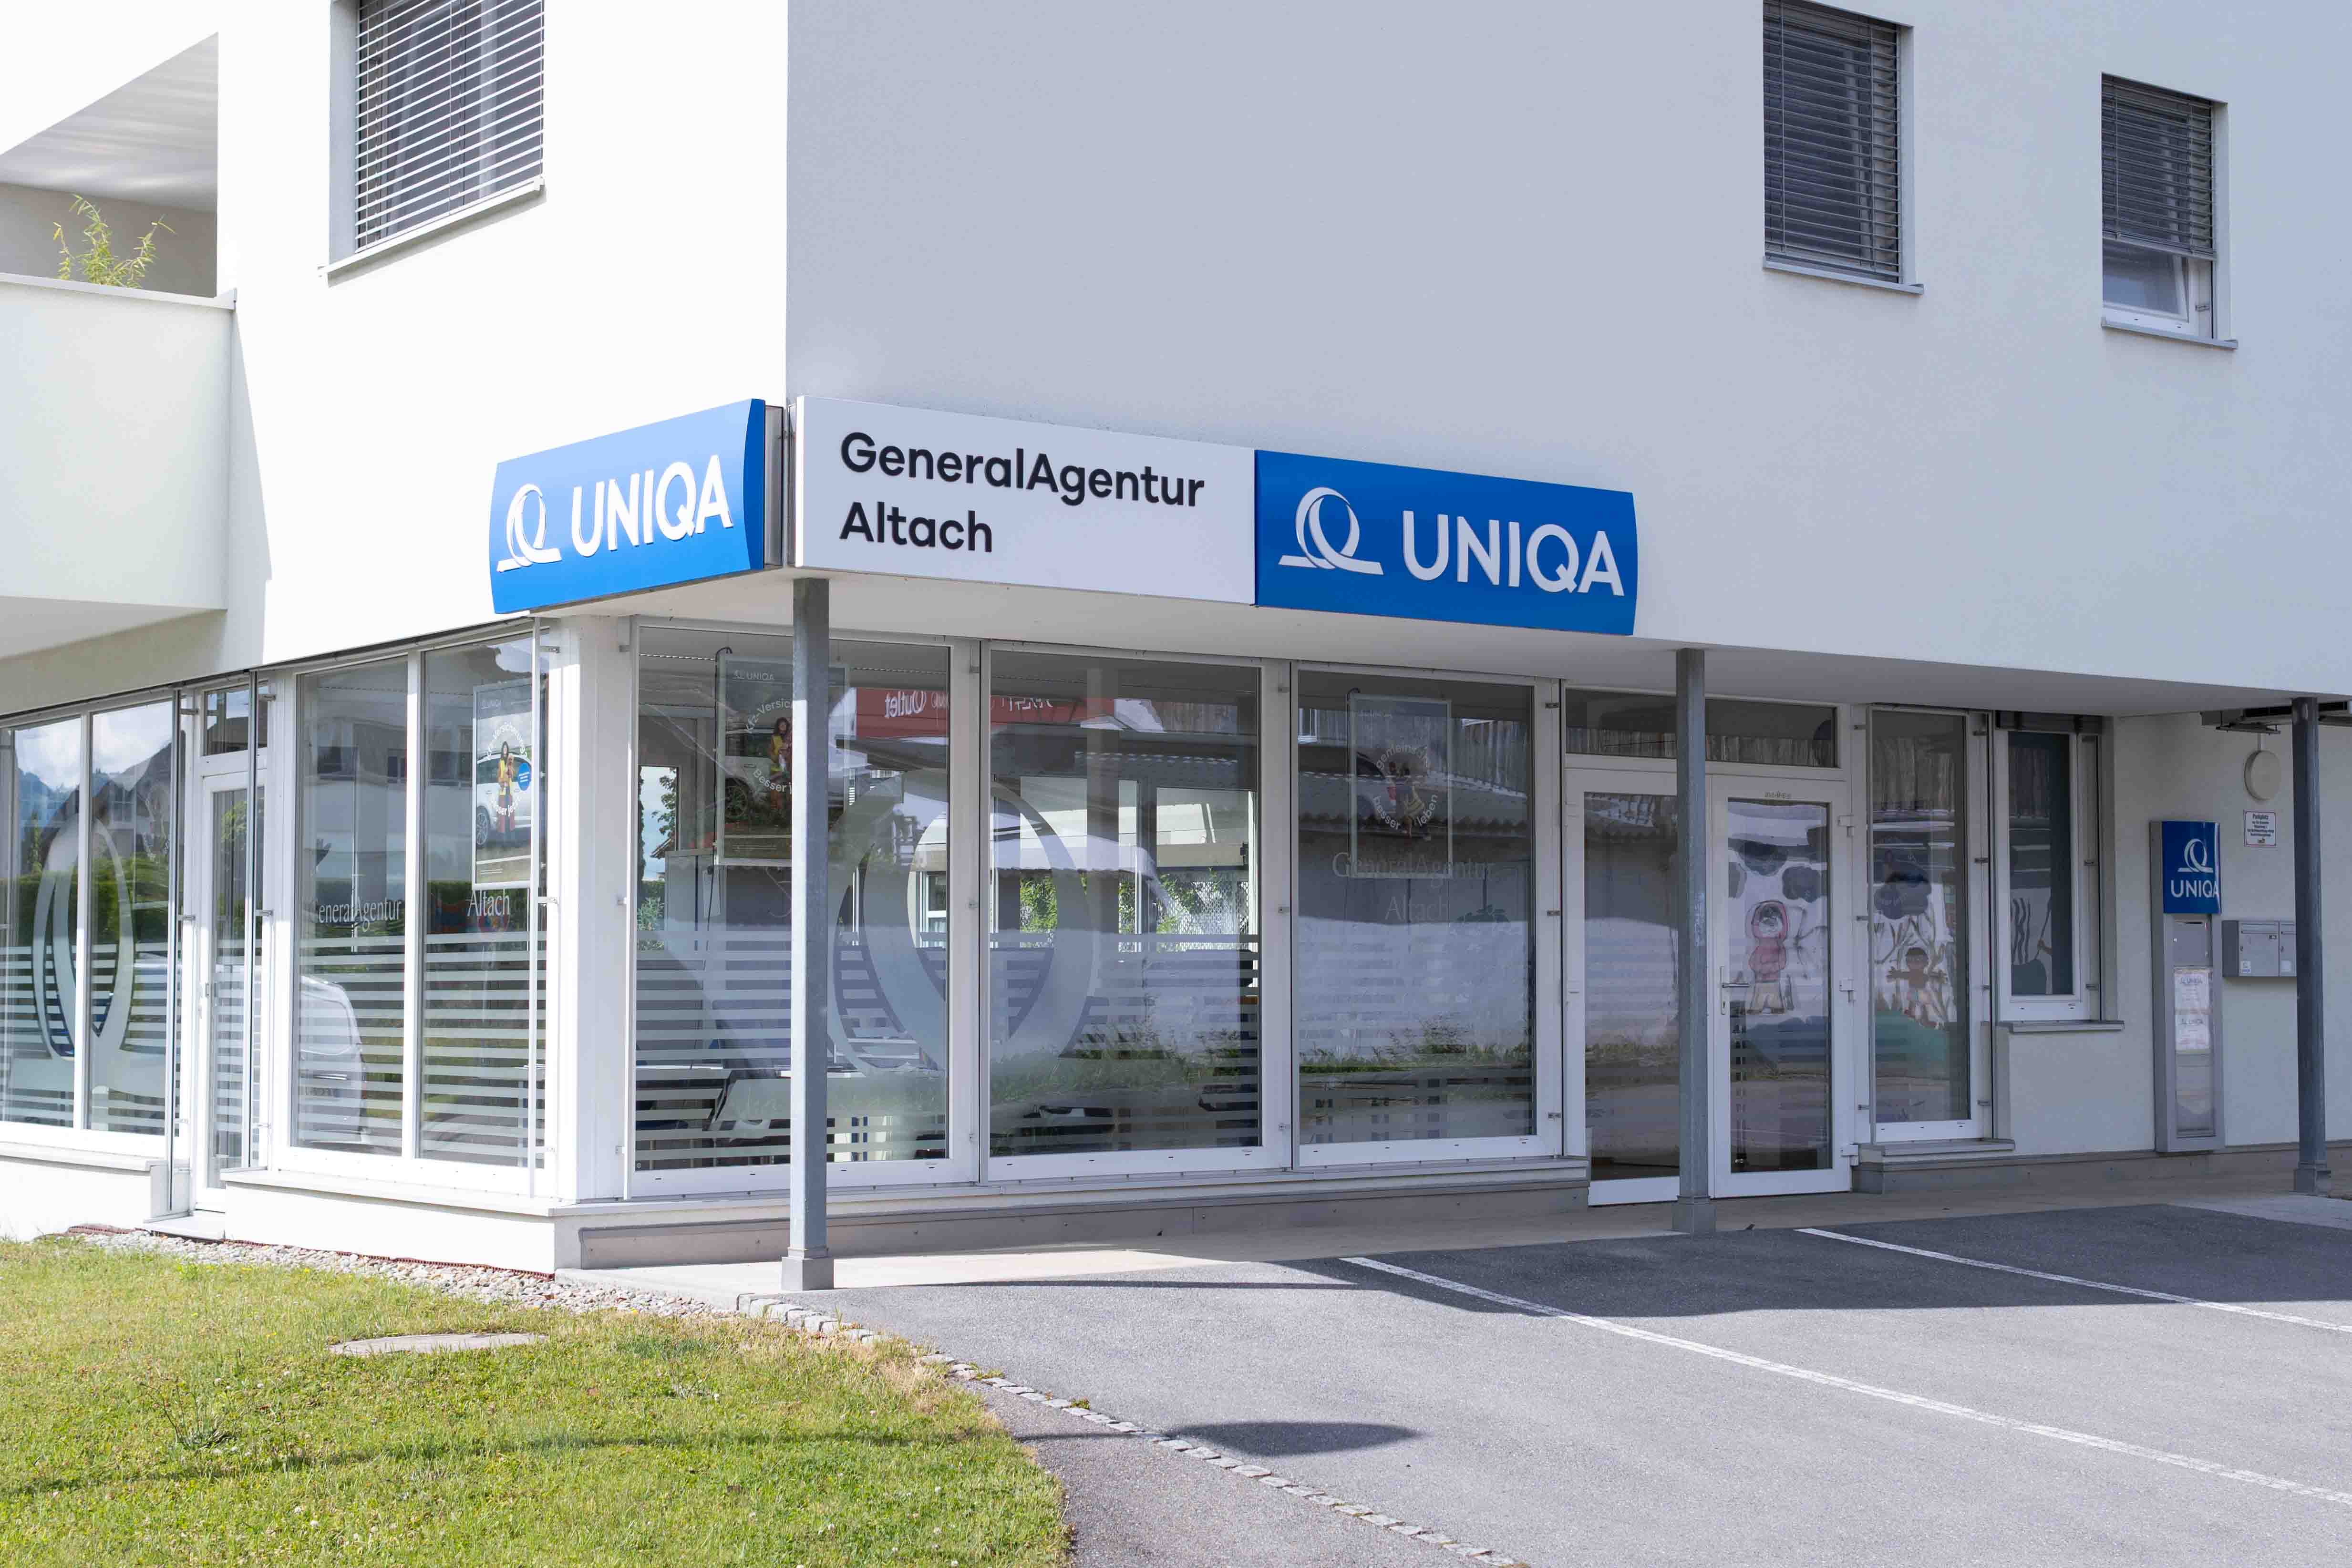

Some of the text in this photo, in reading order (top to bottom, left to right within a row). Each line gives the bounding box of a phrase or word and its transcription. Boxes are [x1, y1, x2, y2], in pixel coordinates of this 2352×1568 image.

[840, 432, 1205, 506] GeneralAgentur
[572, 454, 733, 557] UNIQA
[839, 501, 992, 553] Altach
[1403, 510, 1625, 597] UNIQA
[1416, 794, 1438, 827] leben
[313, 888, 510, 932] eneralAgentur Altach
